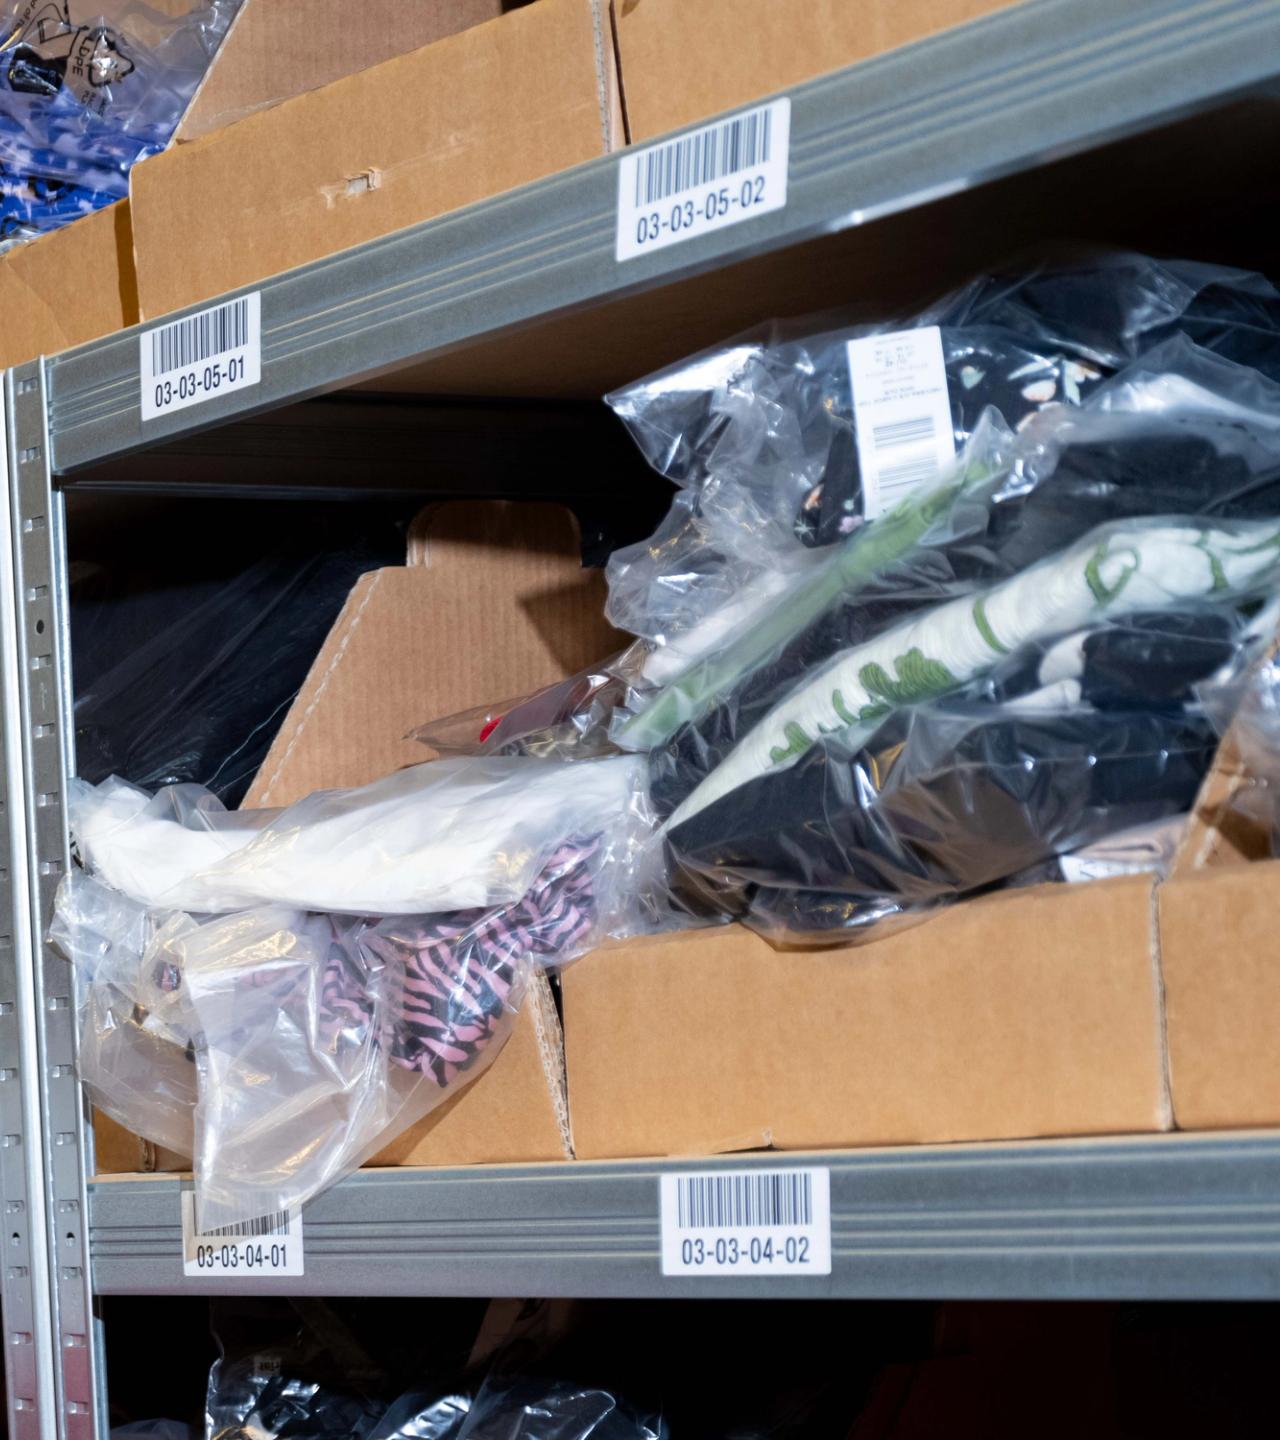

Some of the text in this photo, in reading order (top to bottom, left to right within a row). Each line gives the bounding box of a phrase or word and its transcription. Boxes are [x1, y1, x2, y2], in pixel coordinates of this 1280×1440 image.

[72, 35, 95, 77] LDPE
[636, 175, 766, 244] 03-03-05-02
[154, 355, 244, 408] 03-03-05-01
[196, 1244, 287, 1268] 03-03-04-01
[681, 1236, 811, 1265] 03-03-04-02
